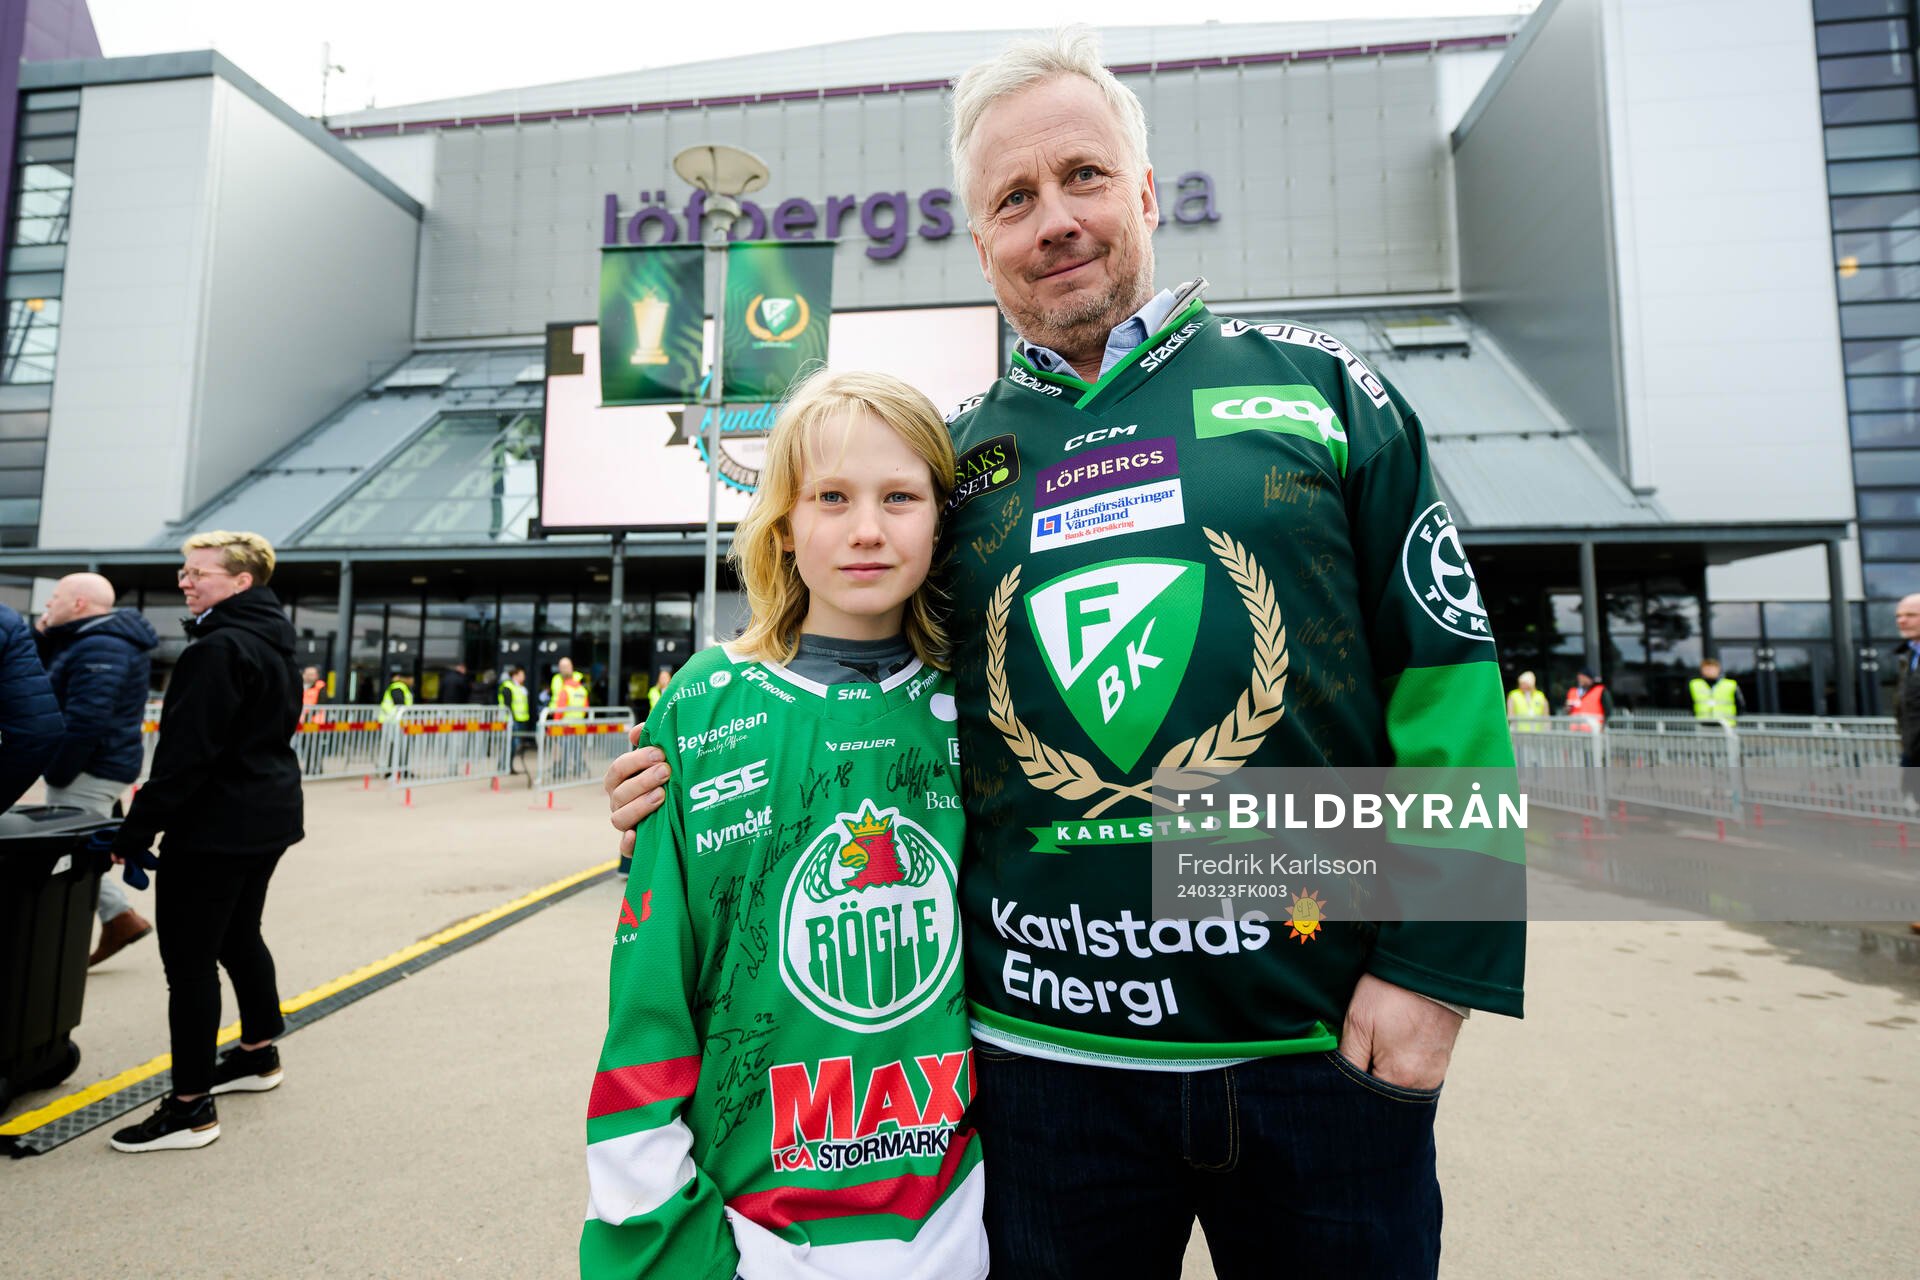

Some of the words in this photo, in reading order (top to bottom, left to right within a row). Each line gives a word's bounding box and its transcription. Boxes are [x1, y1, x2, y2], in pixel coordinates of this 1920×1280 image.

[1139, 320, 1203, 373] stadium
[1008, 365, 1063, 398] stadium
[1211, 396, 1348, 443] coop
[1064, 424, 1138, 452] CCM
[954, 444, 1006, 484] SAKS
[1045, 449, 1165, 493] LÖFBERGS
[1064, 488, 1176, 521] Länsförsäkringar
[1065, 507, 1129, 531] Värmland
[1064, 528, 1084, 541] Bank
[1085, 527, 1092, 536] &
[1092, 520, 1135, 535] Försäkring
[1425, 584, 1488, 633] TEK
[837, 688, 872, 701] SHL
[677, 711, 768, 754] Bevaclean
[839, 738, 896, 752] BAUER
[689, 758, 770, 814] SSE
[925, 791, 963, 811] Bac
[991, 897, 1271, 959] Karlstads
[805, 898, 941, 1003] RÖGLE
[772, 1144, 816, 1173] ICA
